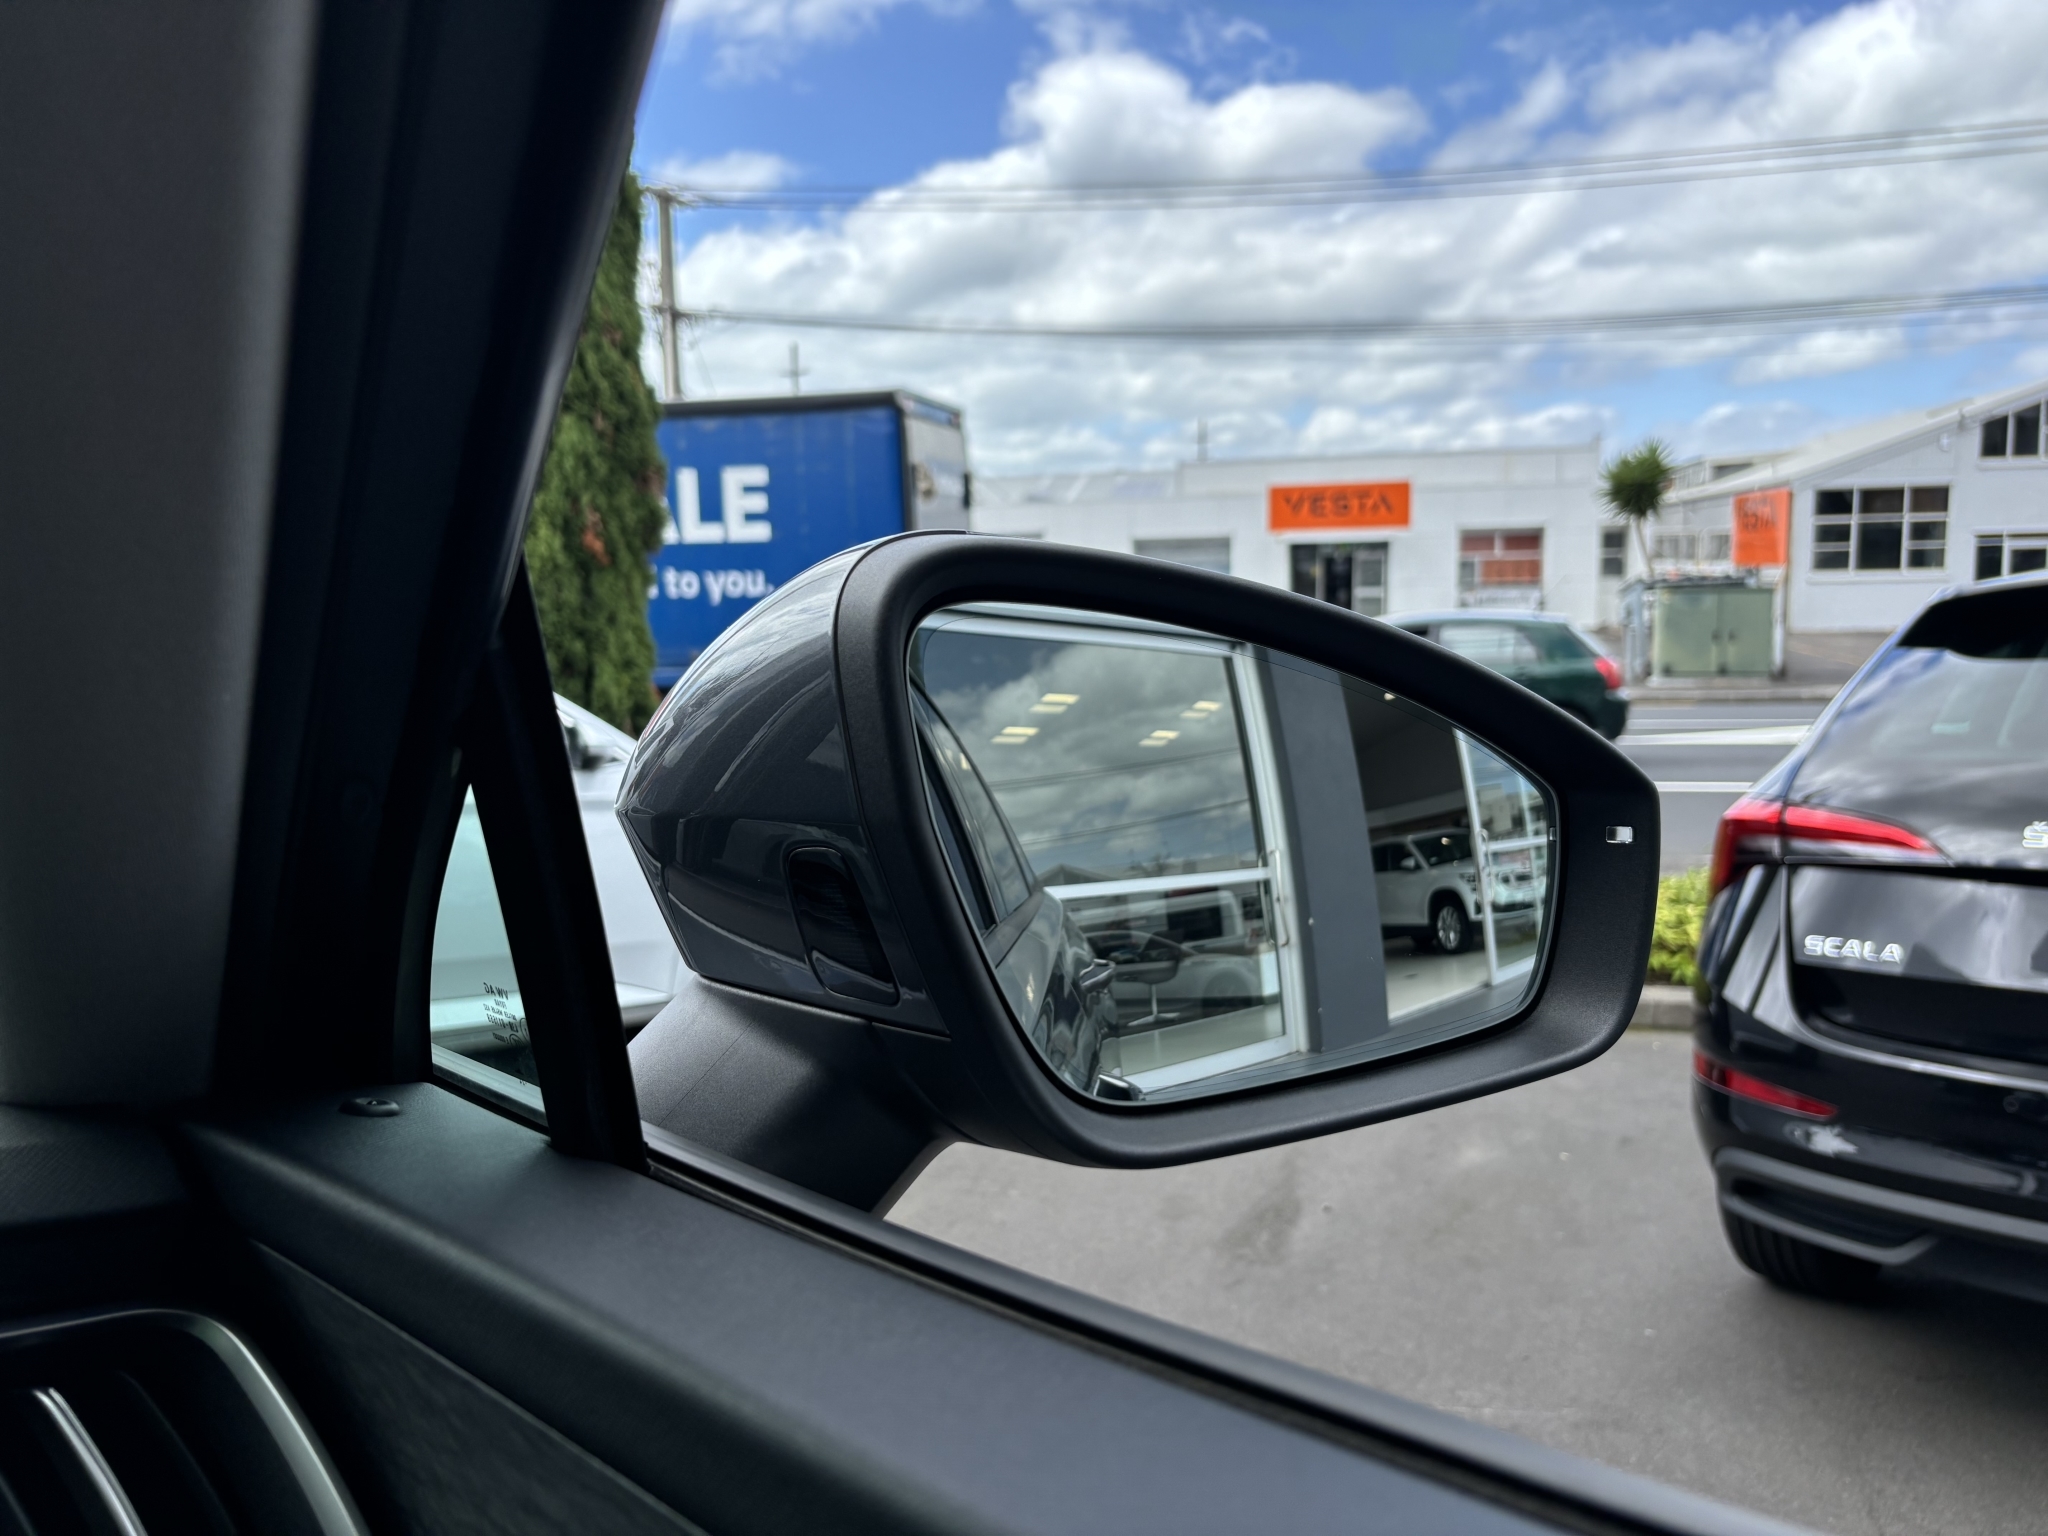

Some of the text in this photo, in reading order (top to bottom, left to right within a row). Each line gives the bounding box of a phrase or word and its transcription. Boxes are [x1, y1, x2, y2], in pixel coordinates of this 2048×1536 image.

[1284, 489, 1393, 518] VESTA
[662, 565, 700, 600] to
[1803, 934, 1904, 964] SCALA
